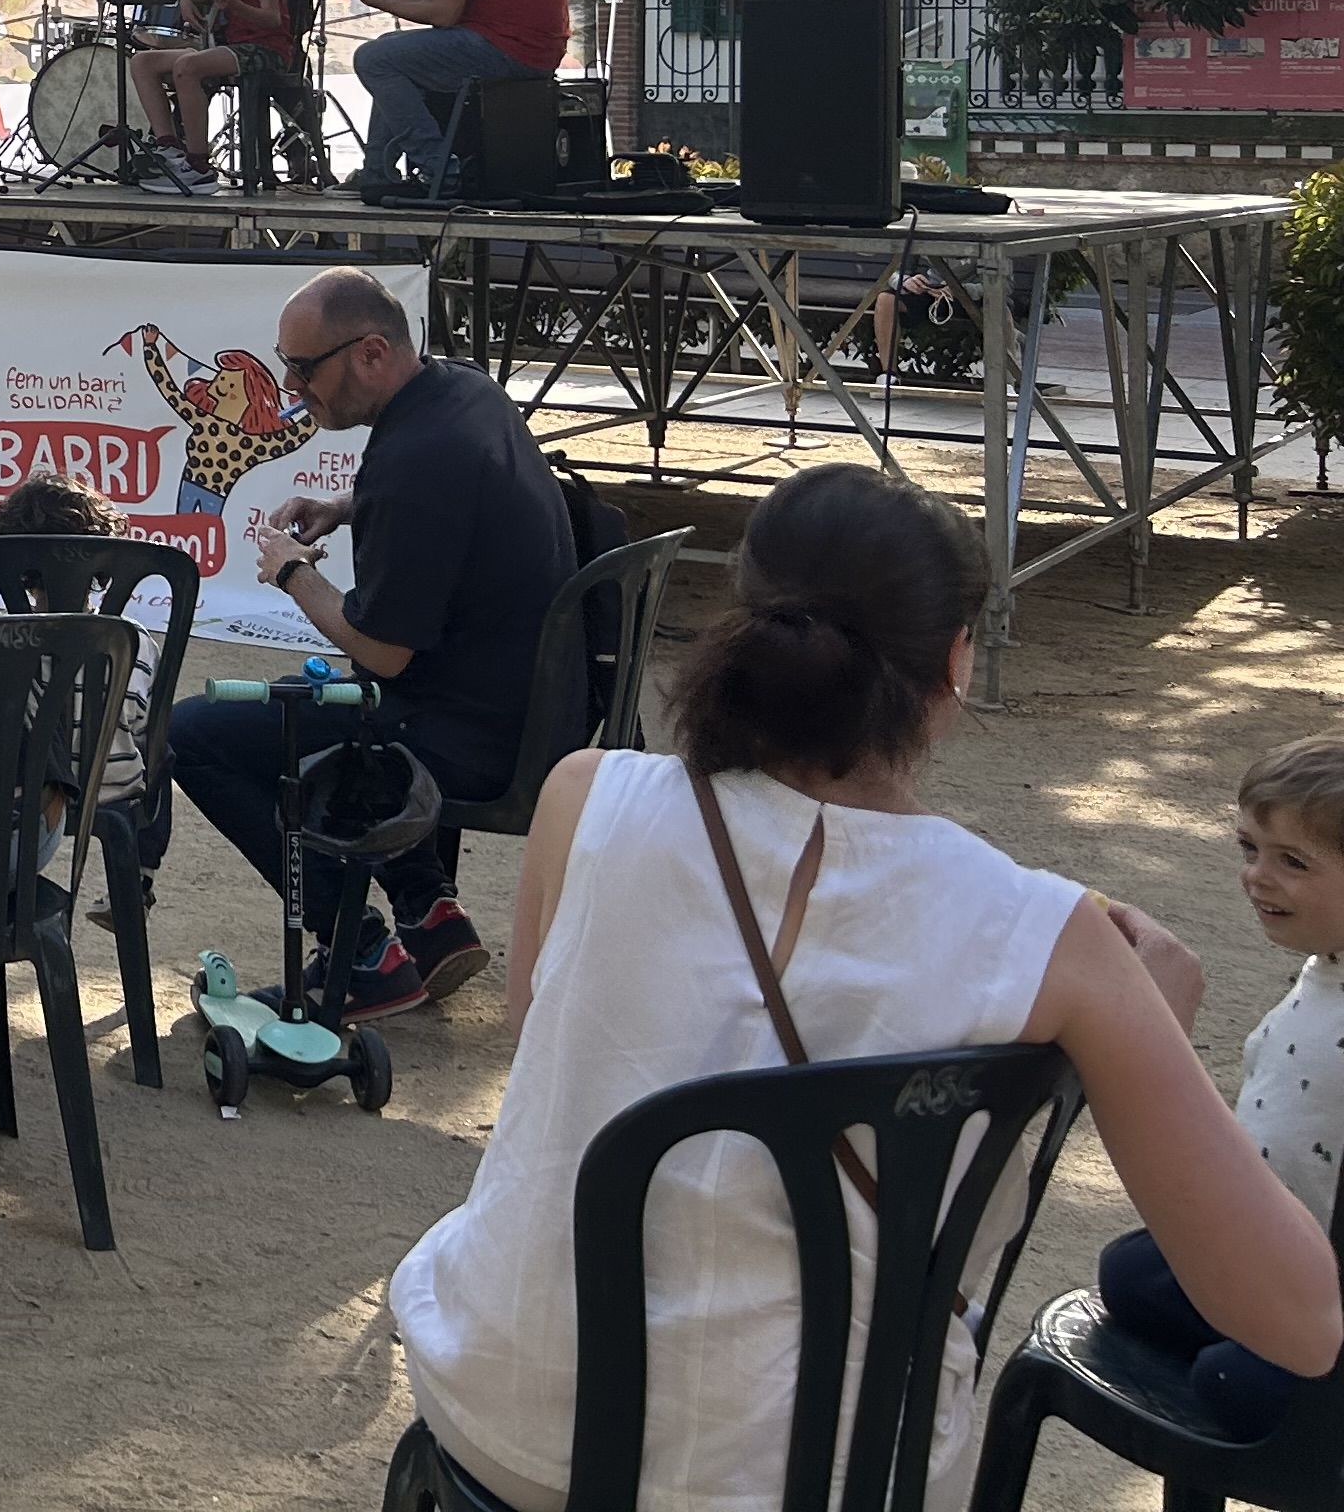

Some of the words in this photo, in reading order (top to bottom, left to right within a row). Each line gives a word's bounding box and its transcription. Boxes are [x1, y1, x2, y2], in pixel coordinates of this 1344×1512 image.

[6, 367, 44, 390] fem
[48, 374, 71, 391] un
[78, 371, 127, 393] barri
[10, 394, 103, 411] SOLIDARI
[319, 451, 355, 471] FEM
[290, 836, 301, 914] SAWYER
